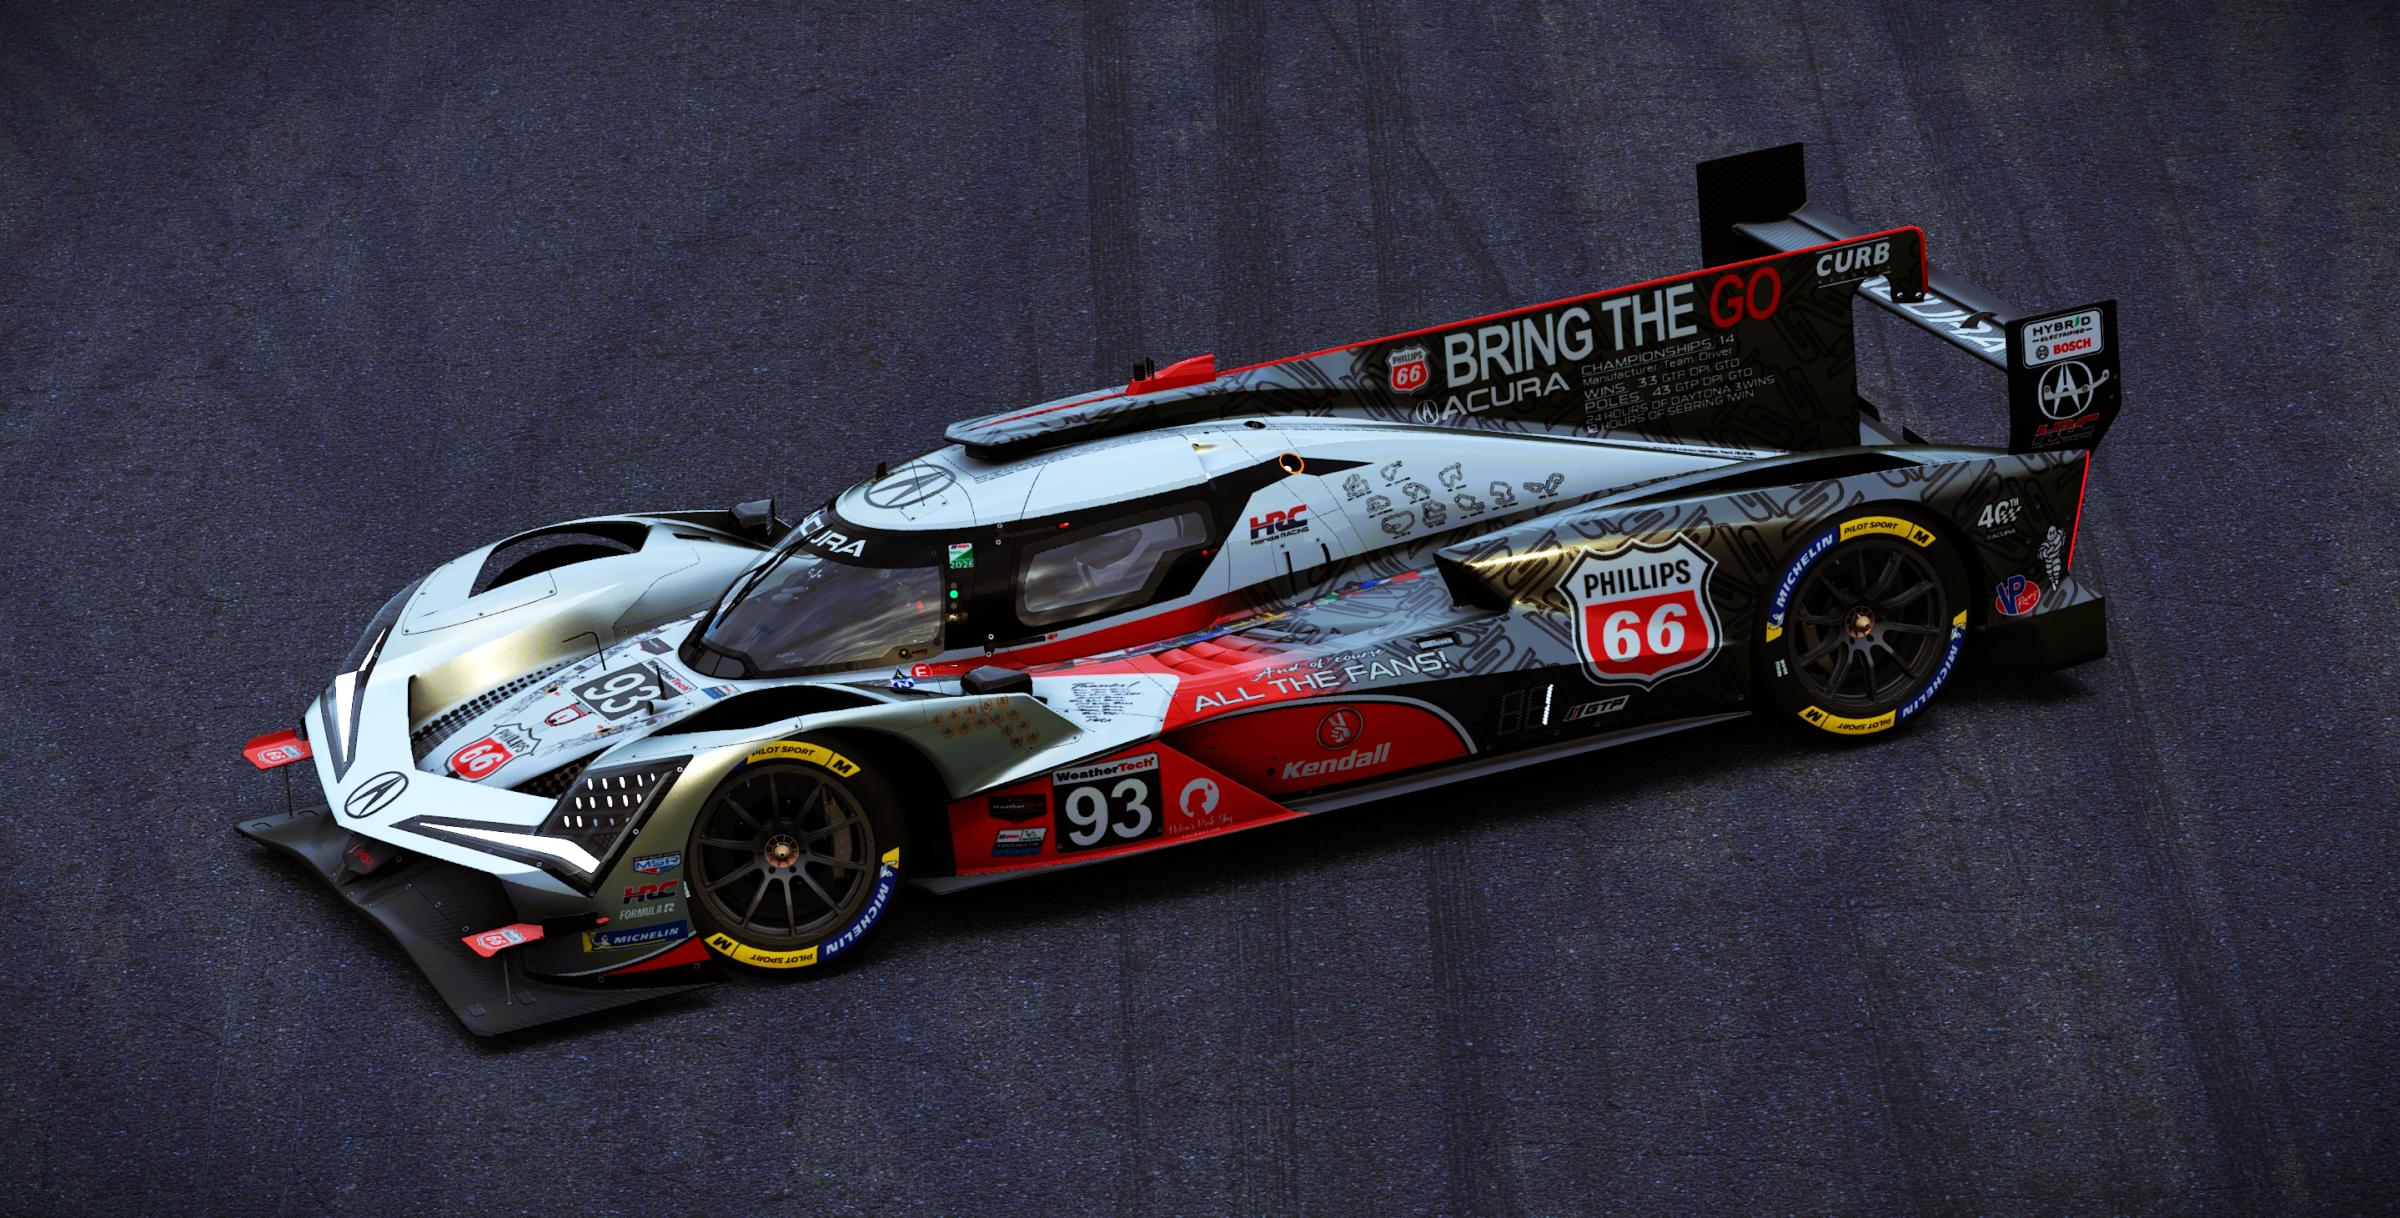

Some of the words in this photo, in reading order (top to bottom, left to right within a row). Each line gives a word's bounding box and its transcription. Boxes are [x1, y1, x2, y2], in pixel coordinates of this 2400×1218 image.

[1816, 241, 1891, 277] CURB
[1444, 306, 1593, 388] BRING
[1602, 282, 1697, 351] THE
[1710, 266, 1781, 328] GO
[1719, 334, 1735, 345] 14
[2053, 338, 2091, 355] BOSCH
[1392, 351, 1423, 365] PHILLIPS
[1396, 364, 1422, 385] 66
[1638, 375, 1658, 388] 33
[1441, 372, 1571, 421] ACURA
[1651, 384, 1671, 396] 43
[1601, 413, 1646, 431] HOURS
[1648, 408, 1665, 421] OF
[1667, 396, 1724, 416] SEBRING
[1604, 402, 1649, 421] HOURS
[1651, 398, 1668, 410] OF
[1671, 385, 1732, 406] DAYTONA
[1250, 504, 1308, 539] HRC
[1844, 522, 1869, 535] PILOT
[1870, 521, 1899, 529] SPORT
[1279, 526, 1310, 539] RACING
[1913, 530, 1930, 544] M
[1584, 558, 1692, 599] PHILLIPS
[1776, 533, 1834, 609] MICHELIN
[1996, 574, 2027, 616] VP
[1602, 603, 1688, 663] 66
[1253, 662, 1302, 682] And
[1309, 658, 1326, 670] of
[1334, 648, 1388, 664] course
[1194, 686, 1266, 713] ALL
[1268, 669, 1341, 694] THE
[1344, 650, 1451, 683] FANS!
[1902, 644, 1959, 718] MICHELIN
[583, 672, 662, 713] 93
[1585, 697, 1625, 715] GTP
[1805, 709, 1823, 722] M
[1837, 722, 1867, 730] SPORT
[1868, 718, 1892, 730] PILOT
[459, 744, 504, 771] 66
[751, 746, 779, 757] PILOT
[781, 745, 816, 757] SPORT
[1282, 742, 1391, 780] Kendall
[832, 759, 852, 775] M
[1056, 757, 1154, 782] WeatherTech
[1065, 777, 1152, 846] 93
[636, 856, 679, 869] MSR
[623, 879, 679, 904] HRC
[619, 904, 663, 921] FORMULA
[825, 884, 890, 955] MICHELIN
[613, 927, 679, 945] MICHELIN
[713, 935, 733, 951] M
[750, 953, 784, 964] SPORT
[785, 953, 813, 963] PILOT
